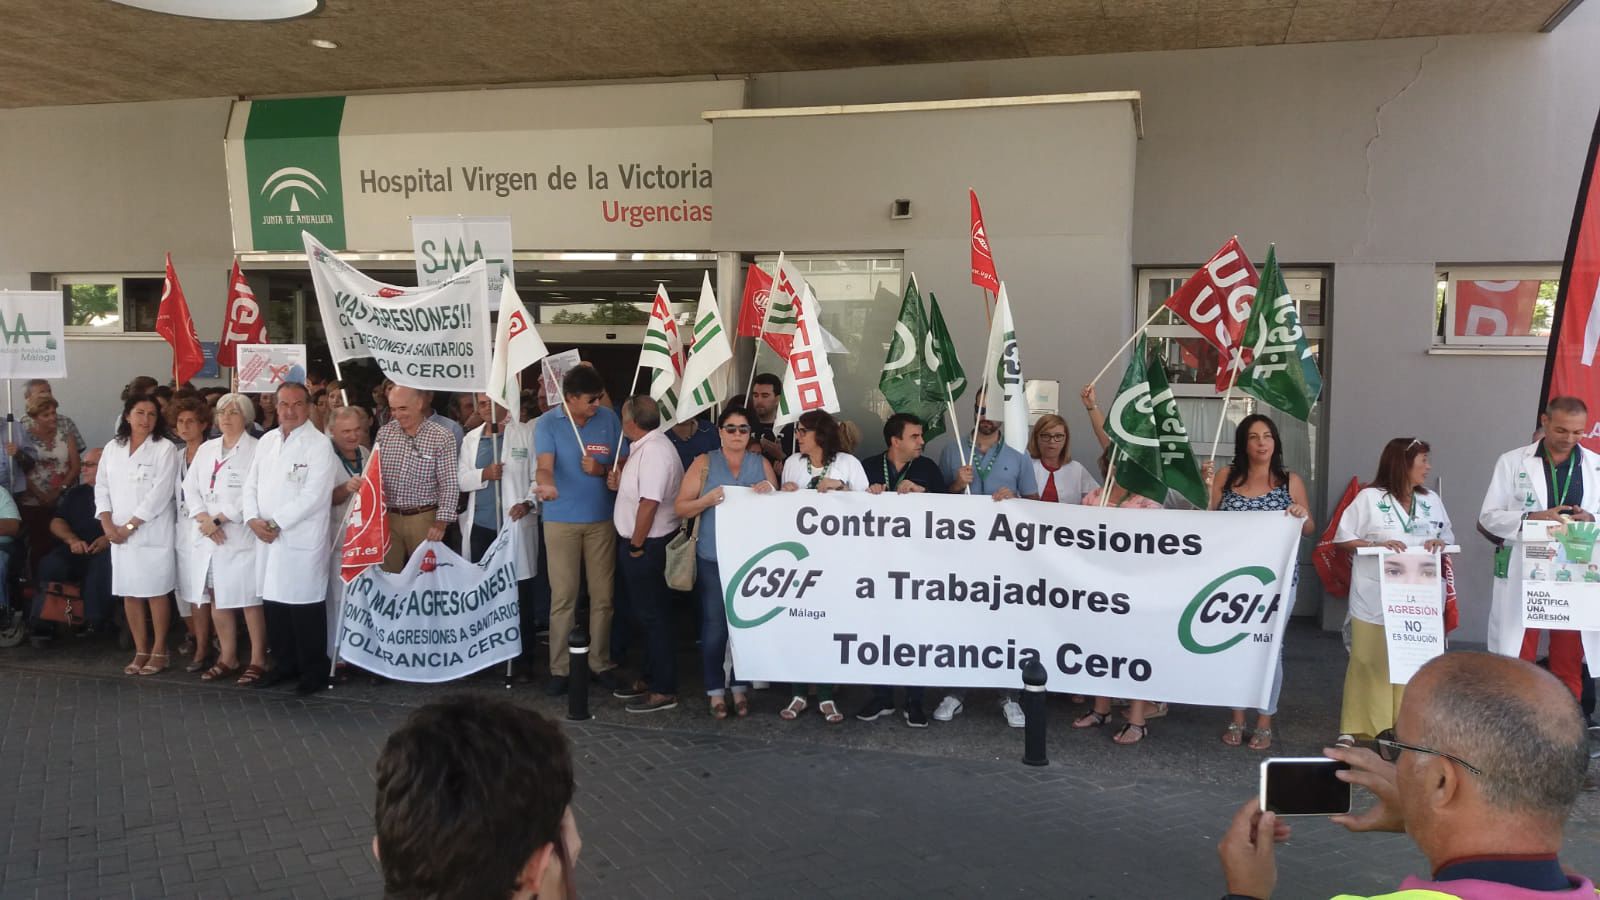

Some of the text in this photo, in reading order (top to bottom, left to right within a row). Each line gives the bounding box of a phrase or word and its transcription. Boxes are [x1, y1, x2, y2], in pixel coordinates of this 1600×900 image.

[360, 162, 712, 199] Hospital Virgen de la Victoria
[262, 215, 284, 225] JUNTA
[286, 215, 295, 225] DE
[602, 200, 712, 228] Urgencias
[412, 341, 474, 357] SANITARIOS
[406, 363, 475, 379] CERO!!
[796, 506, 1203, 556] Contra las Agresiones
[855, 571, 1131, 615] a Trabajadores
[1407, 594, 1416, 603] LA
[1526, 590, 1551, 598] NADA
[1526, 598, 1569, 606] JUSTIFICA
[788, 607, 827, 620] Málaga
[1526, 605, 1546, 613] UNA
[1526, 612, 1570, 622] AGRESIÓN
[1404, 620, 1422, 633] NO
[387, 628, 457, 645] AGRESIONES
[459, 631, 469, 642] A
[1392, 633, 1402, 641] ES
[833, 633, 1152, 682] Tolerancia Cero
